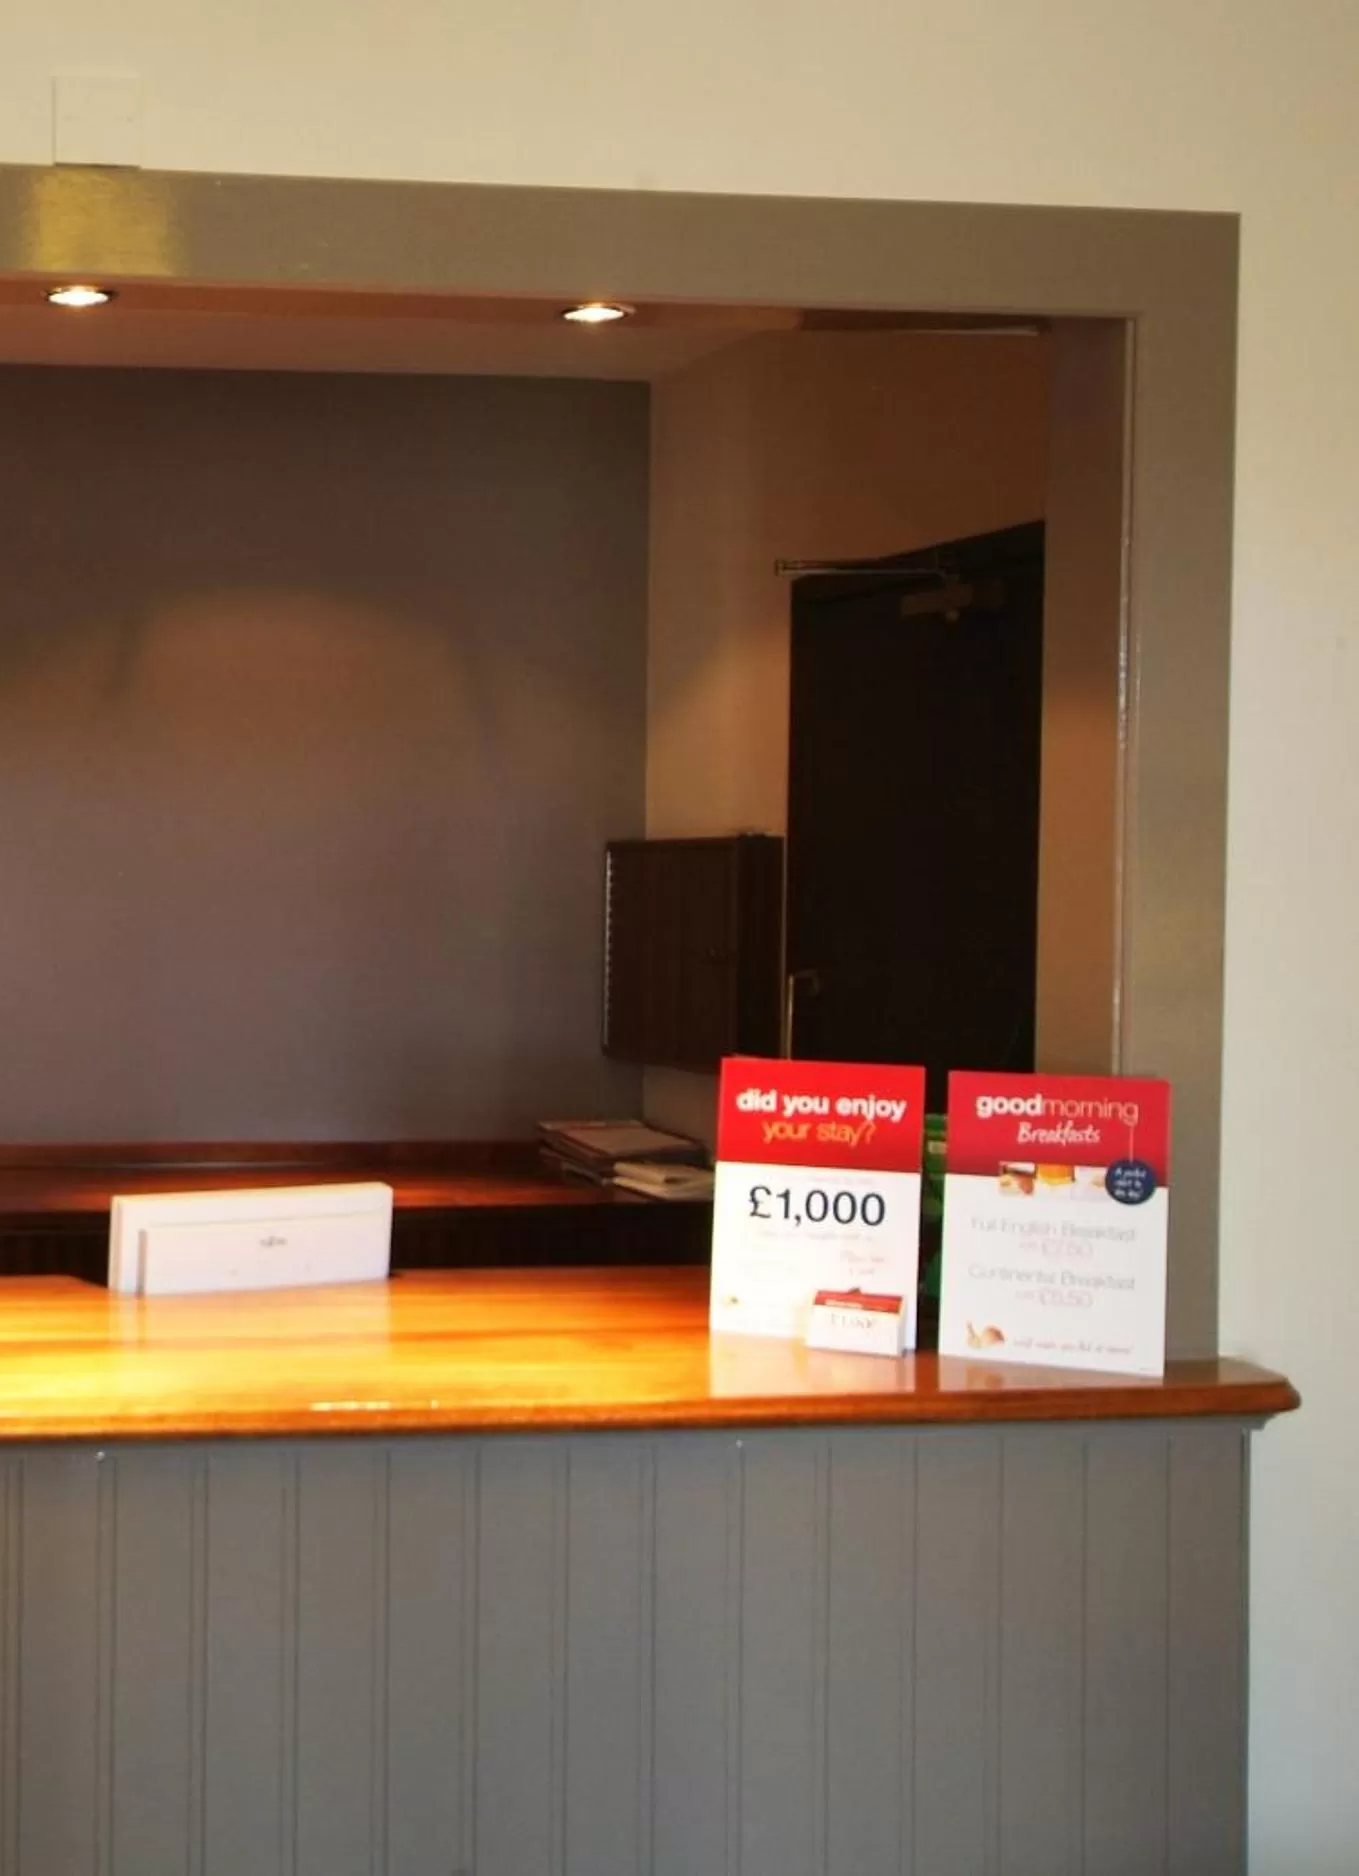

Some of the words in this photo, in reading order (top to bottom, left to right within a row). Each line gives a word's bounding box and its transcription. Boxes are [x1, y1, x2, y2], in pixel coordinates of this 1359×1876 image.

[736, 1088, 776, 1112] did
[783, 1094, 830, 1117] you
[836, 1094, 906, 1122] enjoy
[761, 1120, 811, 1144] your
[817, 1121, 876, 1146] stay?
[1017, 1120, 1100, 1146] Breakfasts
[749, 1185, 886, 1227] £1,000
